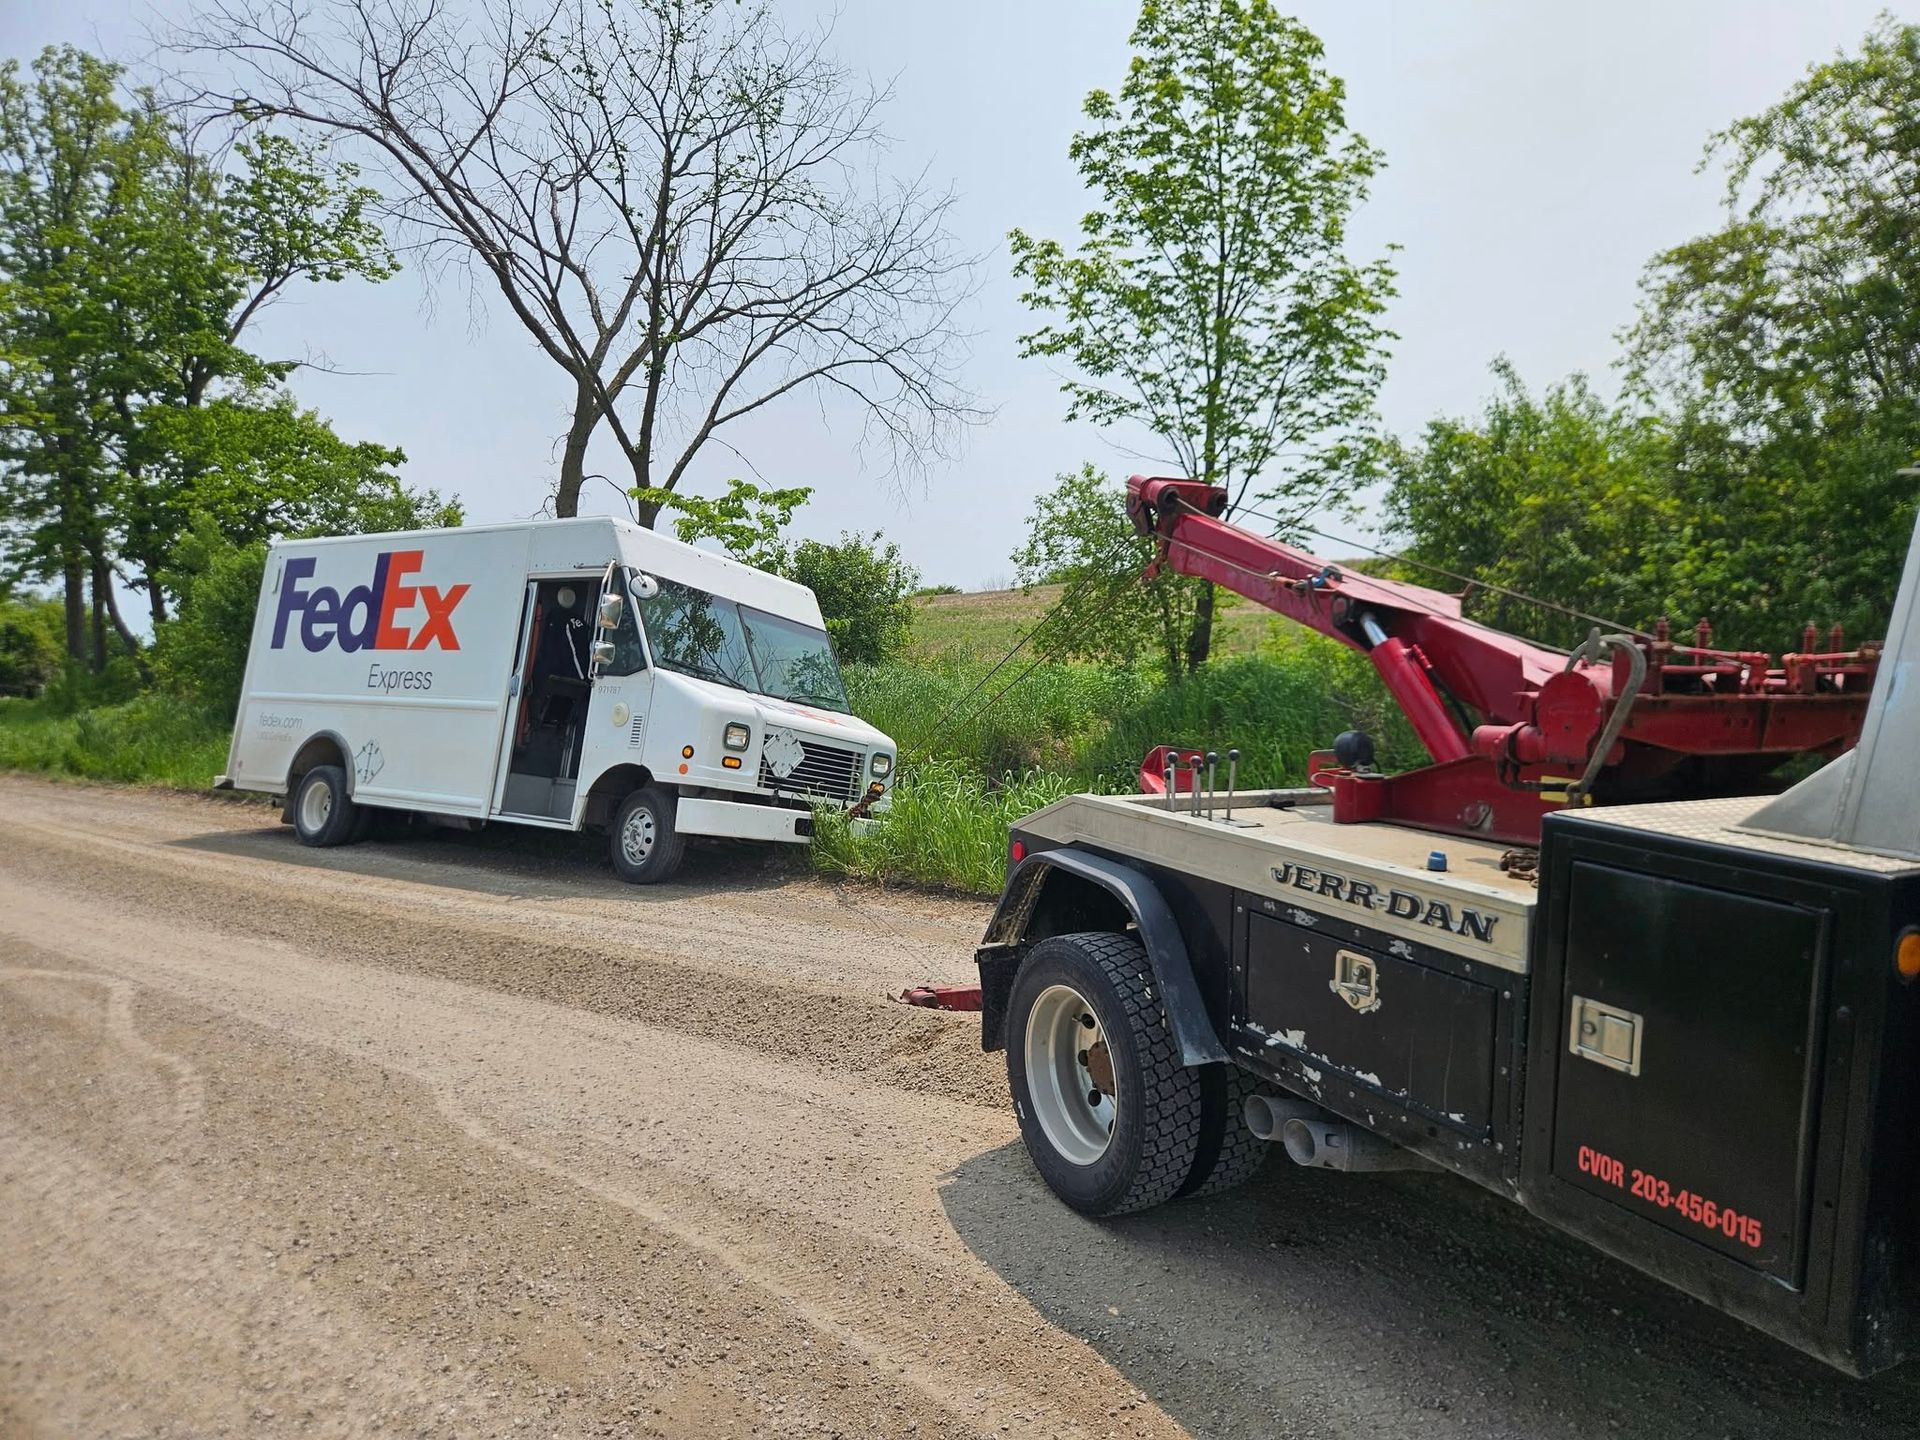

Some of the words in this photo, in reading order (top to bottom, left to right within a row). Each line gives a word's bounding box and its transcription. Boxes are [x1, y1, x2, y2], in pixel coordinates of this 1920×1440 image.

[270, 550, 472, 653] FedEx
[258, 712, 303, 728] fedex.com
[367, 664, 433, 694] Express
[1270, 861, 1499, 943] JERR-DAN
[1577, 1145, 1624, 1188] CVOR
[1630, 1169, 1762, 1248] 203-456-015
